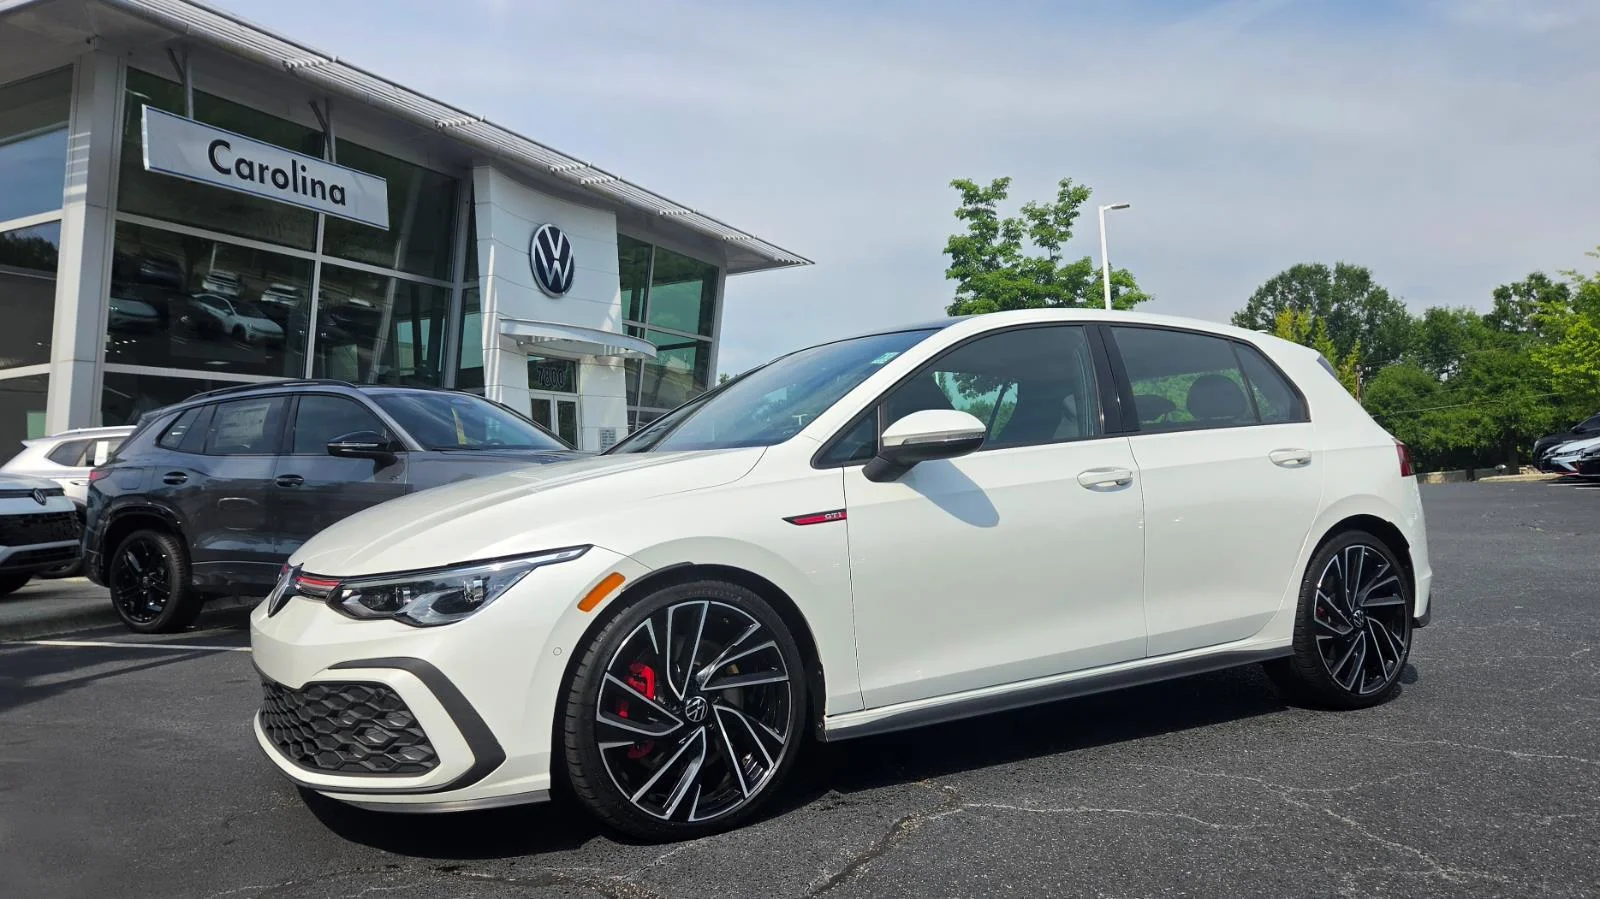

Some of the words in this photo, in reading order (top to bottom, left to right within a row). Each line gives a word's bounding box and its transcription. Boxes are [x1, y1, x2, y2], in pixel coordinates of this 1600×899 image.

[208, 139, 346, 206] Carolina
[531, 223, 574, 296] VW
[537, 366, 565, 388] 7800
[825, 512, 843, 520] GTI
